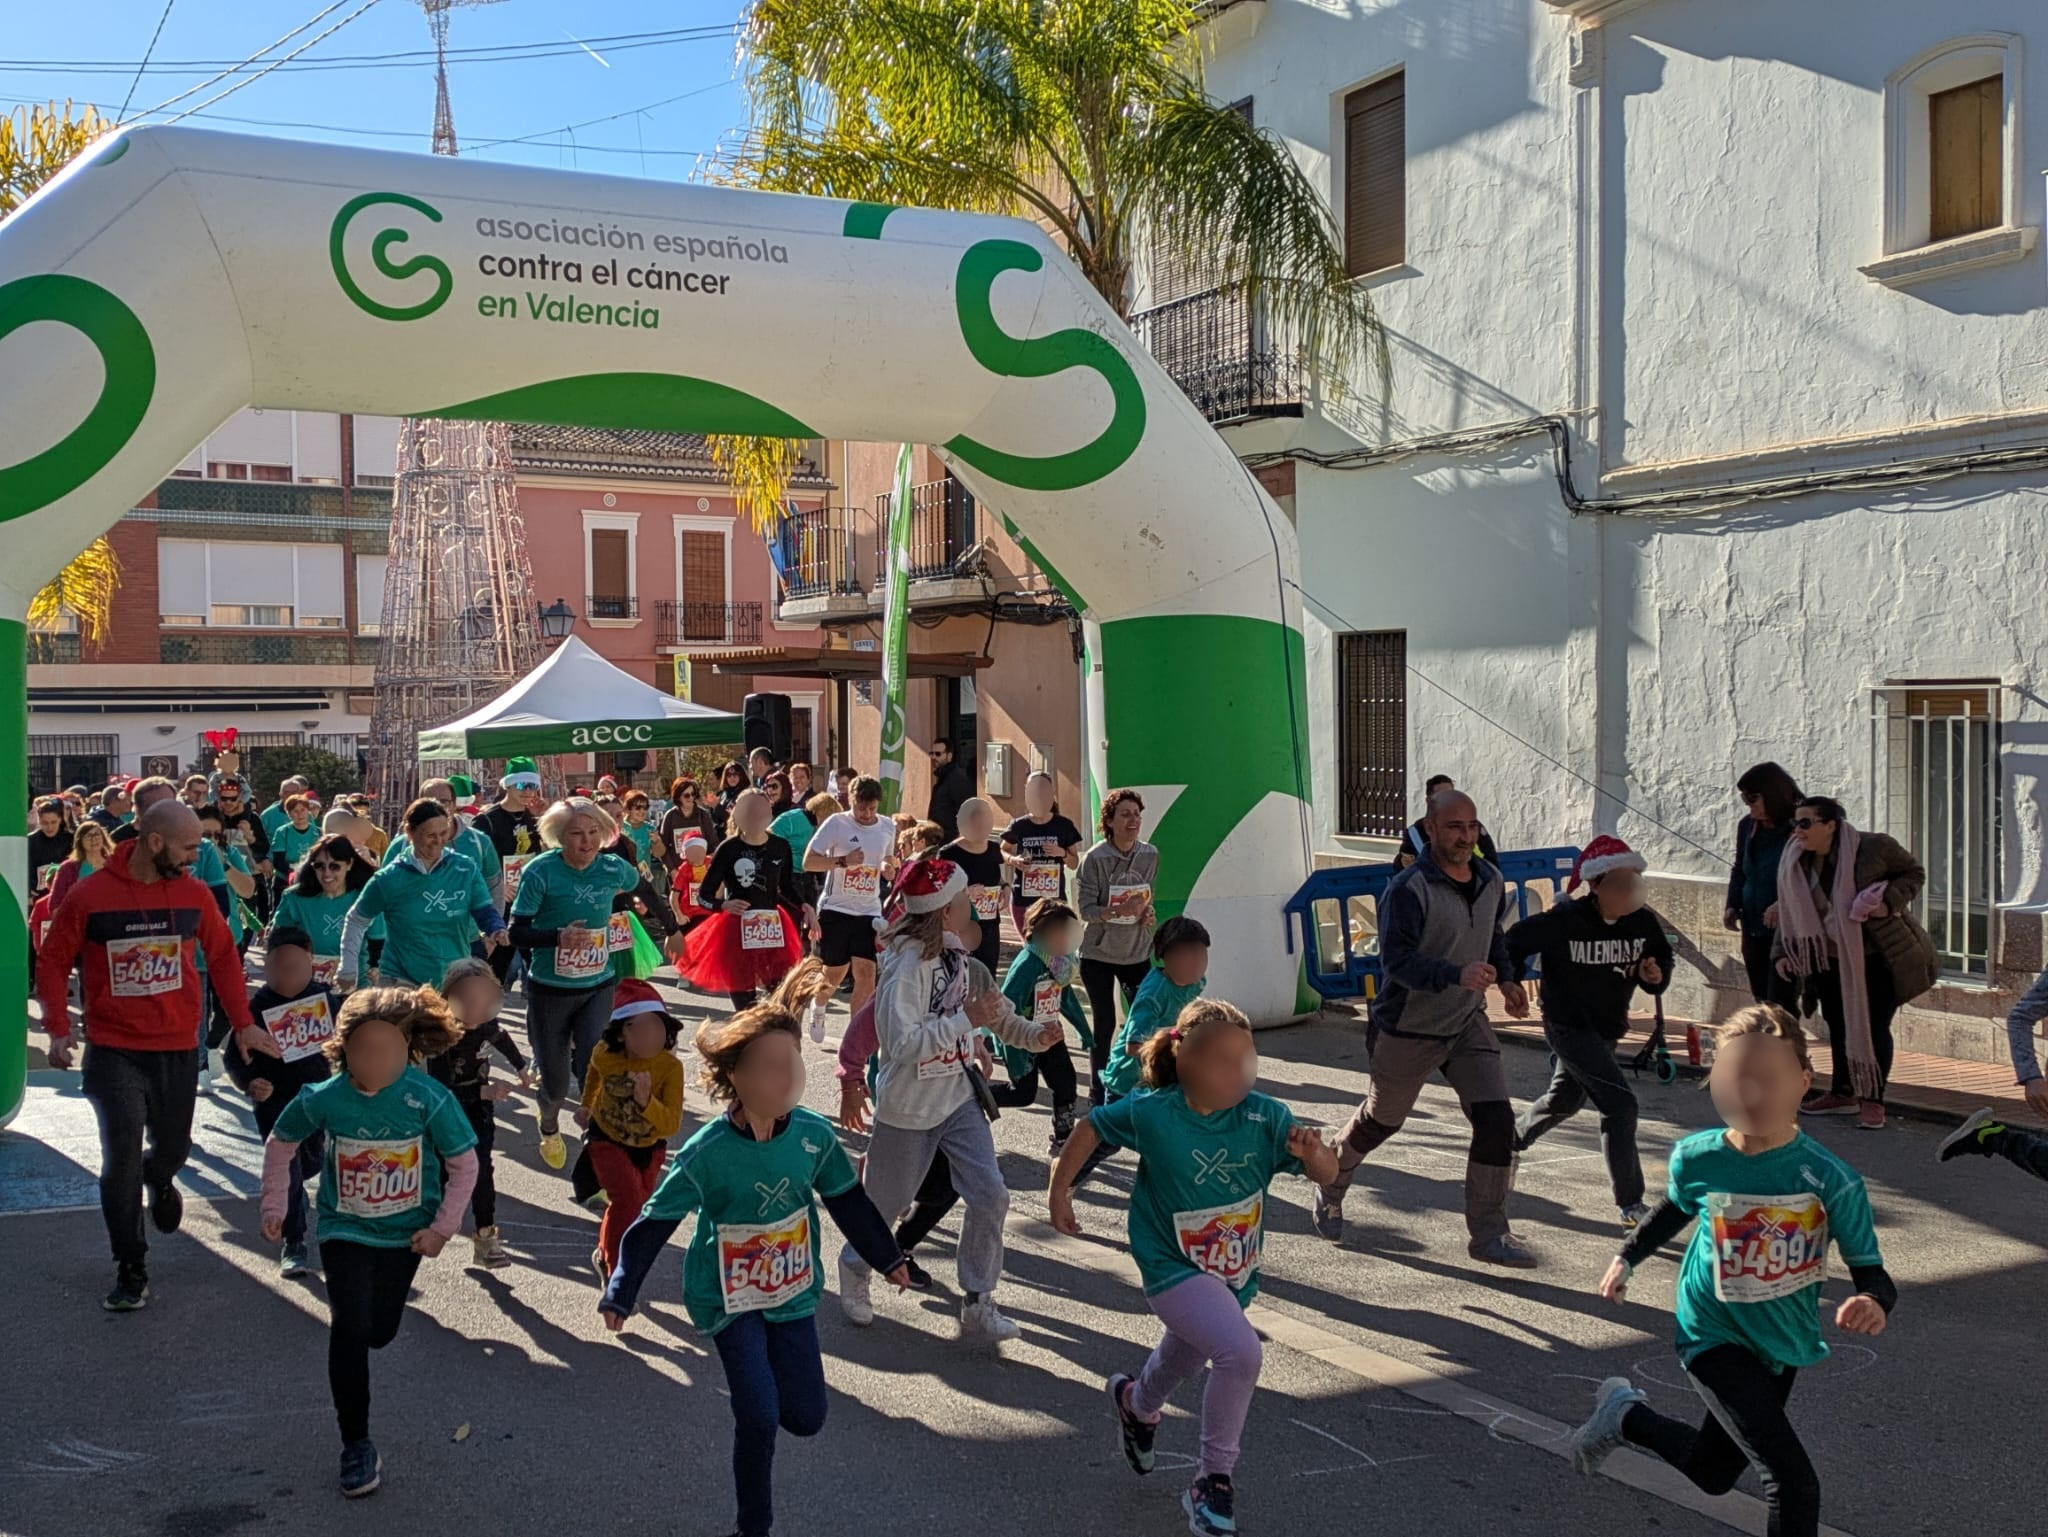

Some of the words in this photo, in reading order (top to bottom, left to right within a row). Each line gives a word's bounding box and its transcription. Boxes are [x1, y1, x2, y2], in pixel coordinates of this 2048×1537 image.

[476, 216, 645, 251] asociación
[652, 233, 789, 264] española
[478, 253, 583, 283] contra
[591, 258, 618, 286] el
[626, 262, 730, 295] cáncer
[477, 294, 517, 318] en
[525, 291, 660, 329] Valencia
[571, 724, 653, 746] aecc
[744, 923, 781, 940] 54965
[114, 956, 180, 982] 54847
[558, 944, 606, 967] 54920
[1568, 939, 1631, 965] VALENCIA
[274, 1016, 331, 1051] 54848
[341, 1164, 418, 1200] 55000
[730, 1245, 807, 1290] 54819
[1722, 1229, 1824, 1277] 54997
